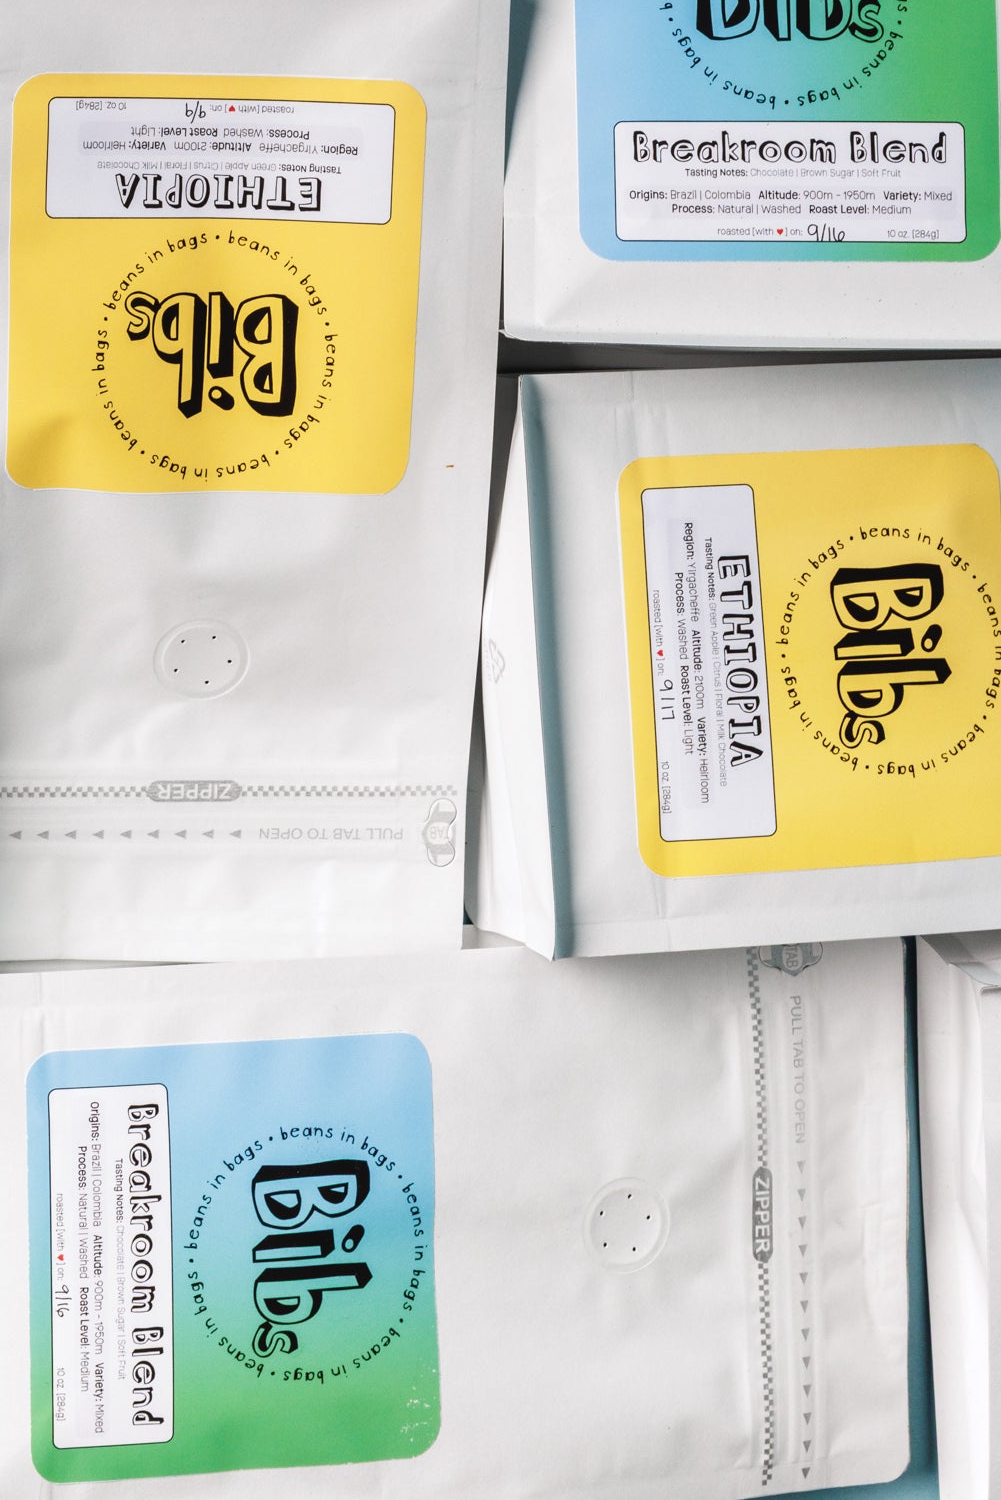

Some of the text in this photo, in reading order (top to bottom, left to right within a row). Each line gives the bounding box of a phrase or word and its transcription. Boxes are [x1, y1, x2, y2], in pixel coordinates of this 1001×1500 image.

[130, 124, 309, 140] Process: Washed Roast Level: Light
[185, 102, 206, 123] 9/9
[633, 130, 946, 164] Breakroom Blend
[115, 173, 321, 211] ETHIOPIA
[672, 203, 911, 214] Process: Natural Washed Roast Level: Medium
[807, 223, 845, 240] 9/16
[125, 291, 298, 418] Bibs
[682, 522, 710, 803] Region: Yirgacheffe Altitude: 2100m Variety: Heirloom
[717, 555, 763, 767] ETHIOPIA
[830, 563, 952, 748] Bibs
[659, 679, 674, 720] 9/17
[157, 782, 231, 800] ZIPPER
[259, 827, 403, 841] PULL TAB TO OPEN
[790, 995, 805, 1145] PULL TAB TO OPEN
[755, 1177, 770, 1254] ZIPPER
[127, 1103, 164, 1425] Breakroom Blend
[252, 1159, 372, 1358] Bibs
[55, 1285, 71, 1317] 9/16
